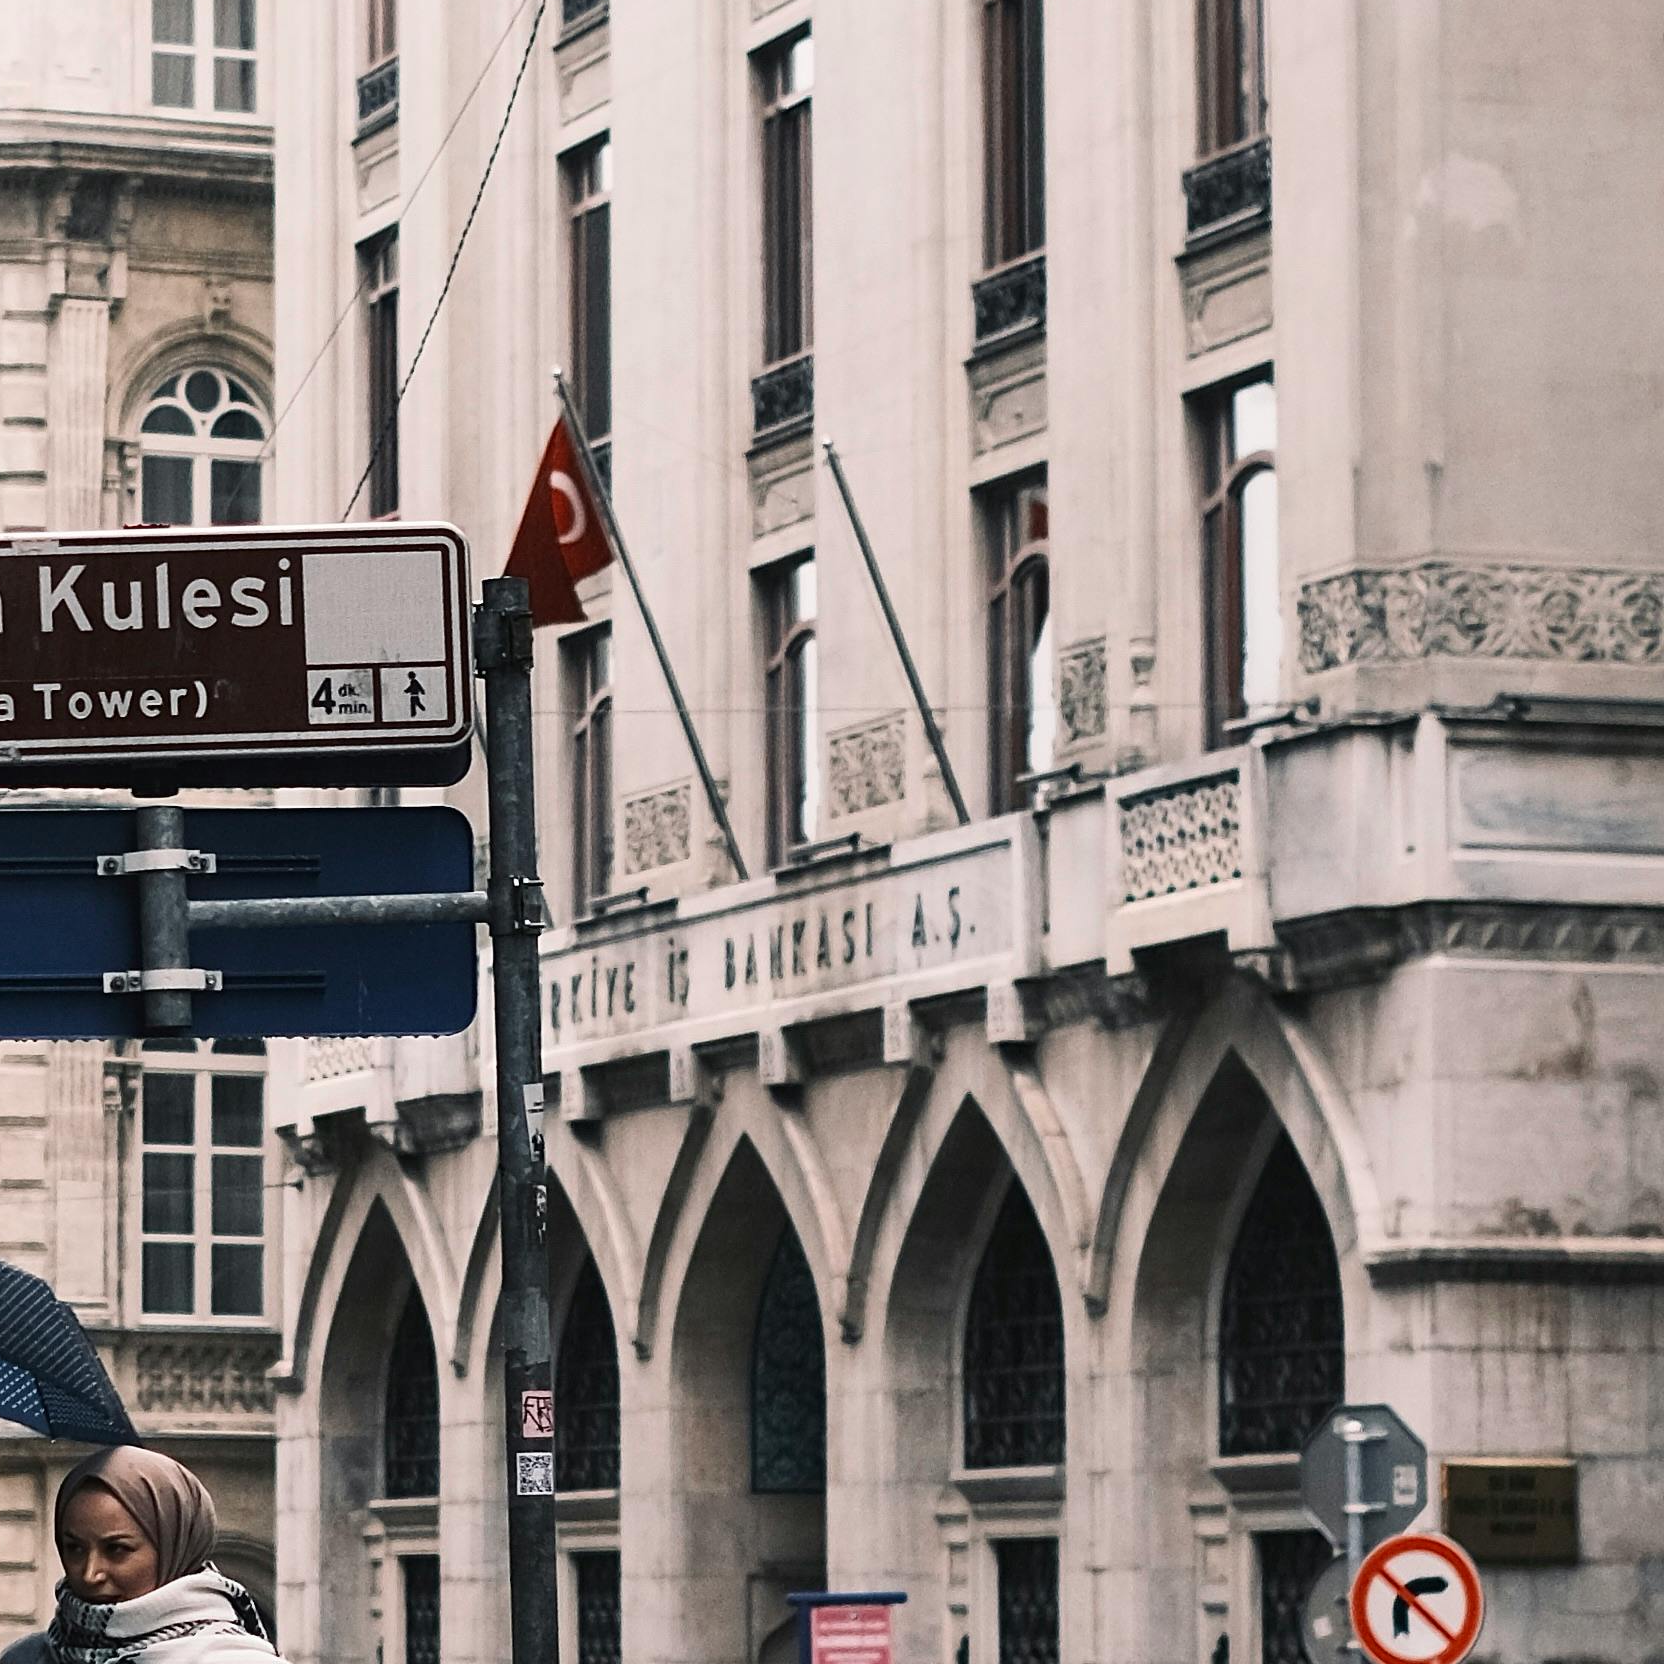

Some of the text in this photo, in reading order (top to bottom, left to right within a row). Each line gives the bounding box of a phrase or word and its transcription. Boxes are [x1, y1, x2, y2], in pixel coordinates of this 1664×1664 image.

[39, 558, 293, 632] Kulesi
[33, 681, 207, 720] Tower)
[312, 677, 336, 715] 4
[338, 701, 371, 714] min.
[551, 956, 635, 1030] RKİYE
[724, 902, 873, 991] BANKASI
